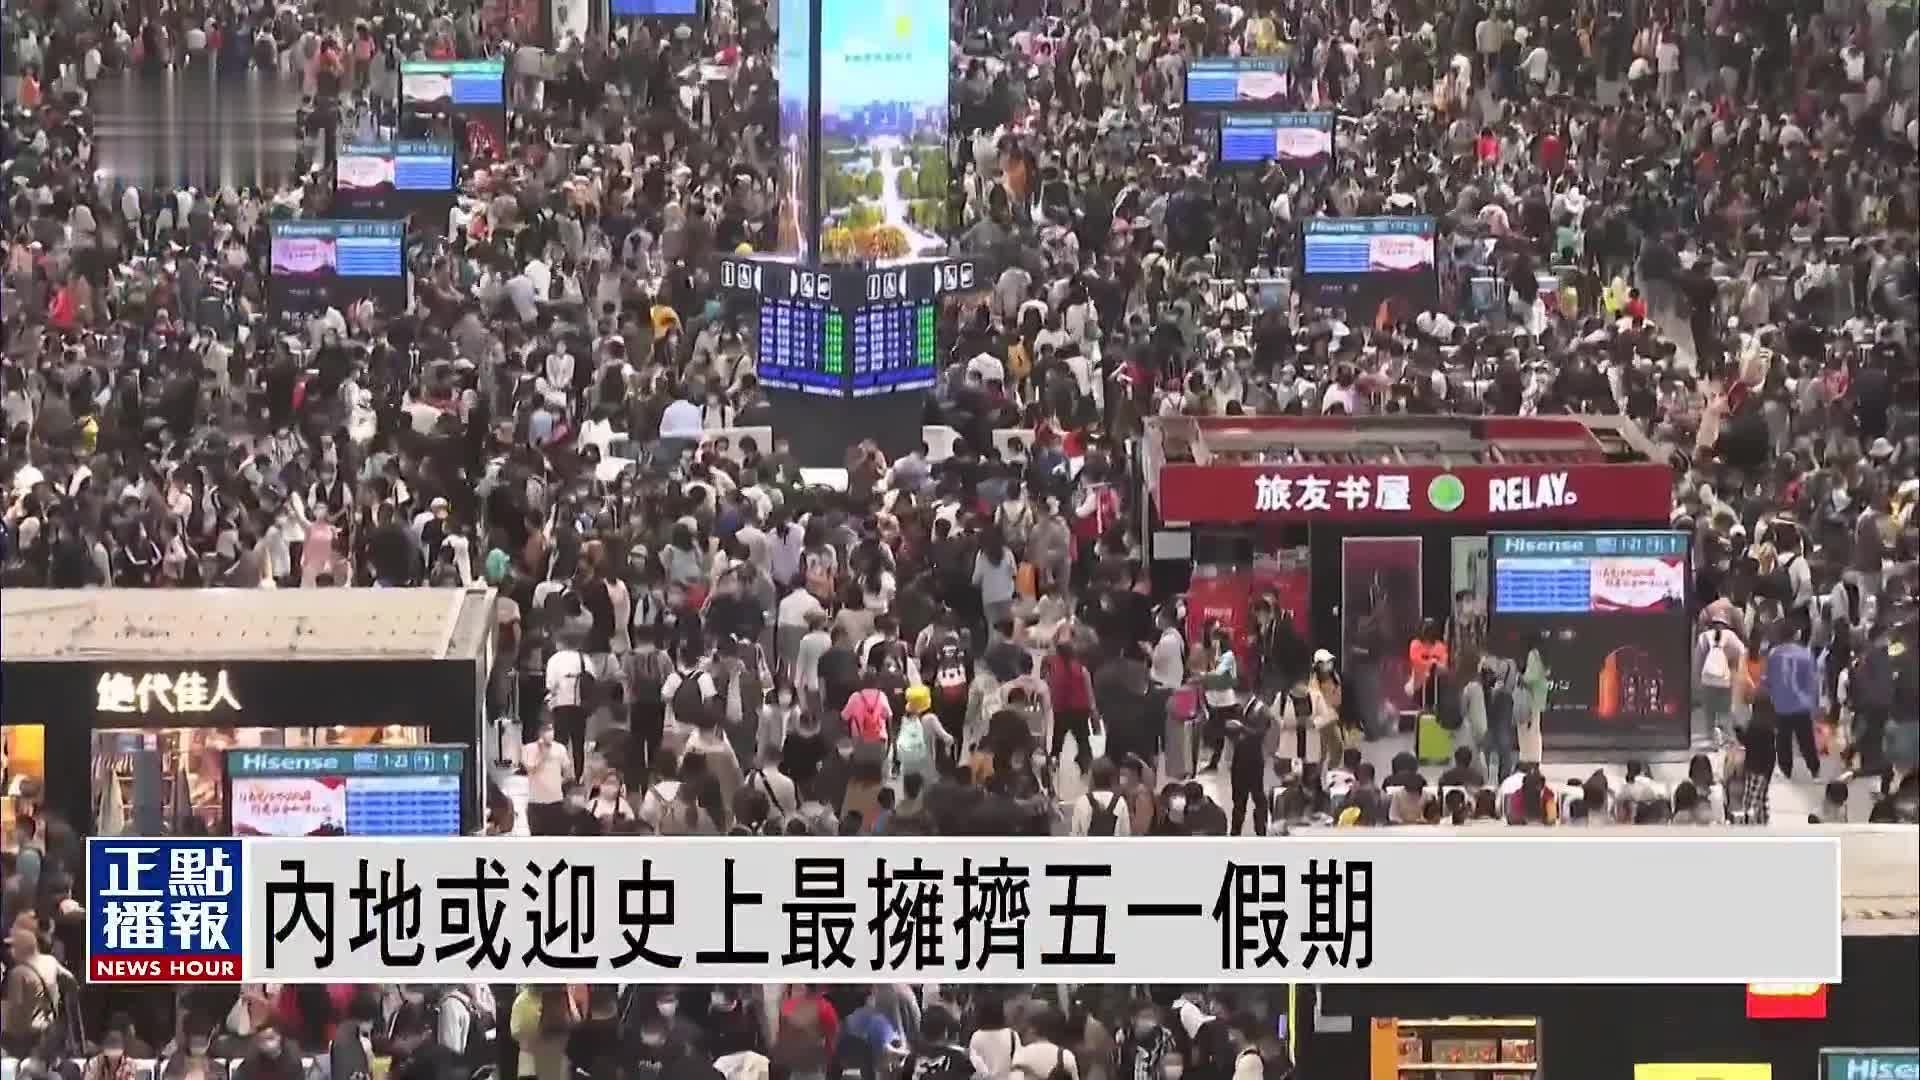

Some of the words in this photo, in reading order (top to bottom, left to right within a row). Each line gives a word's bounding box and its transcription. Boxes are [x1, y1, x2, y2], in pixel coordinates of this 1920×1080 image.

[1255, 474, 1411, 511] 旅友书屋
[1505, 536, 1584, 553] Hisense
[96, 669, 243, 714] 绝代佳人
[242, 753, 339, 771] Hisense
